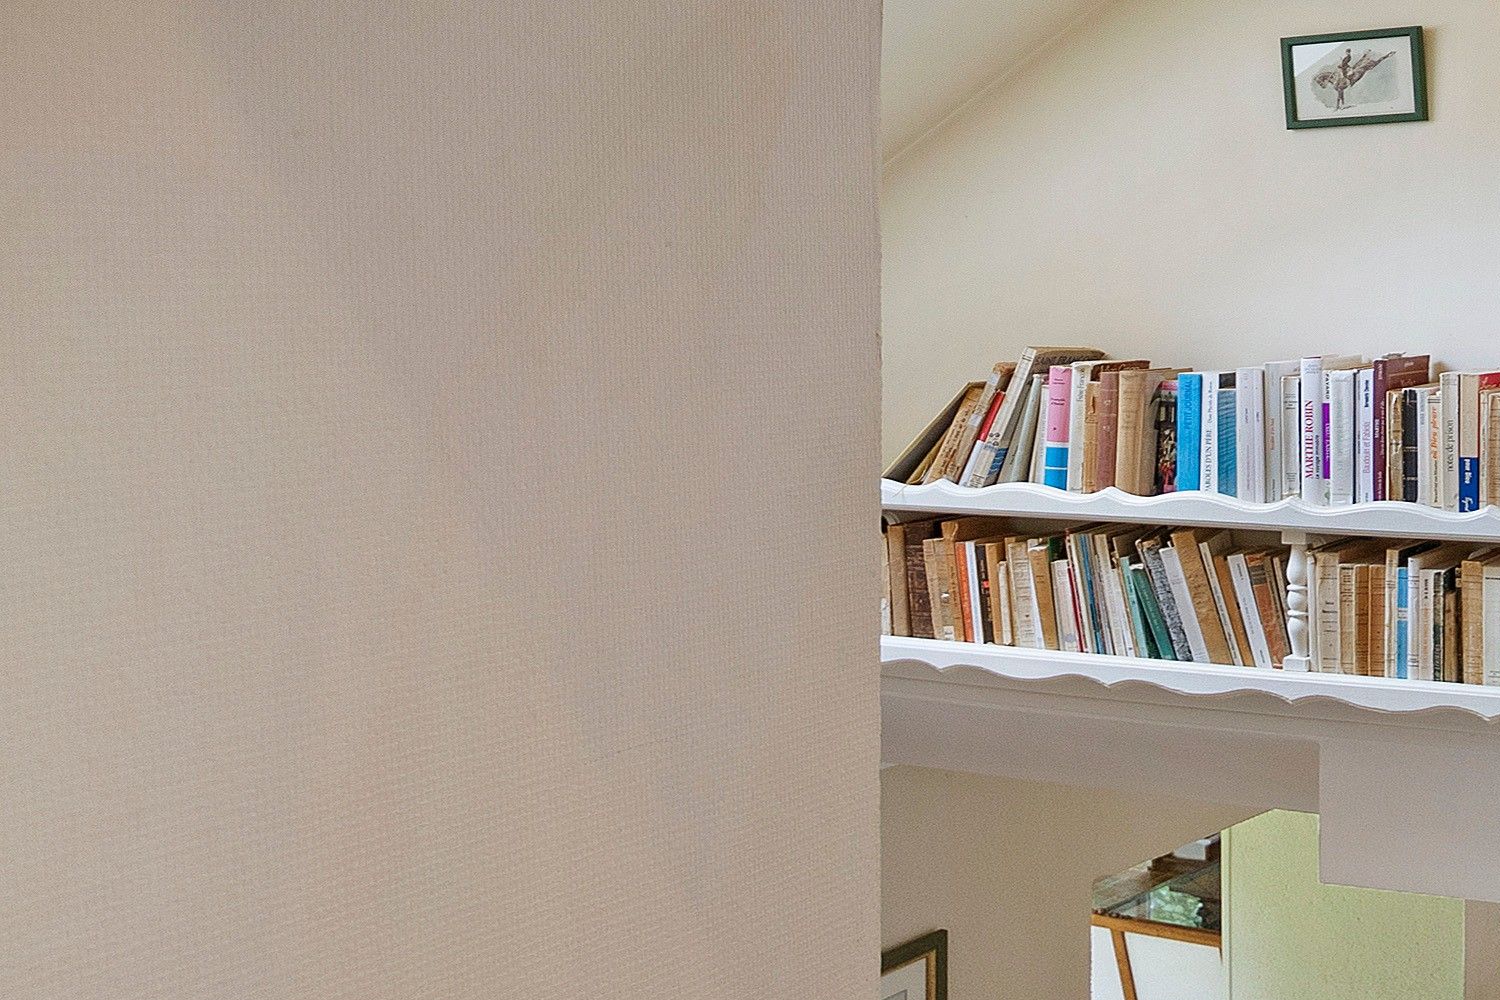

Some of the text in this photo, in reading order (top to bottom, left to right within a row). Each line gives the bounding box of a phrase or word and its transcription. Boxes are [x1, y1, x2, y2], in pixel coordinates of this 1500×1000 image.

[1431, 407, 1439, 429] pleure
[1204, 445, 1212, 463] D'UN
[1305, 400, 1314, 479] MARTHE ROBIN
[1446, 419, 1455, 472] notes de prison
